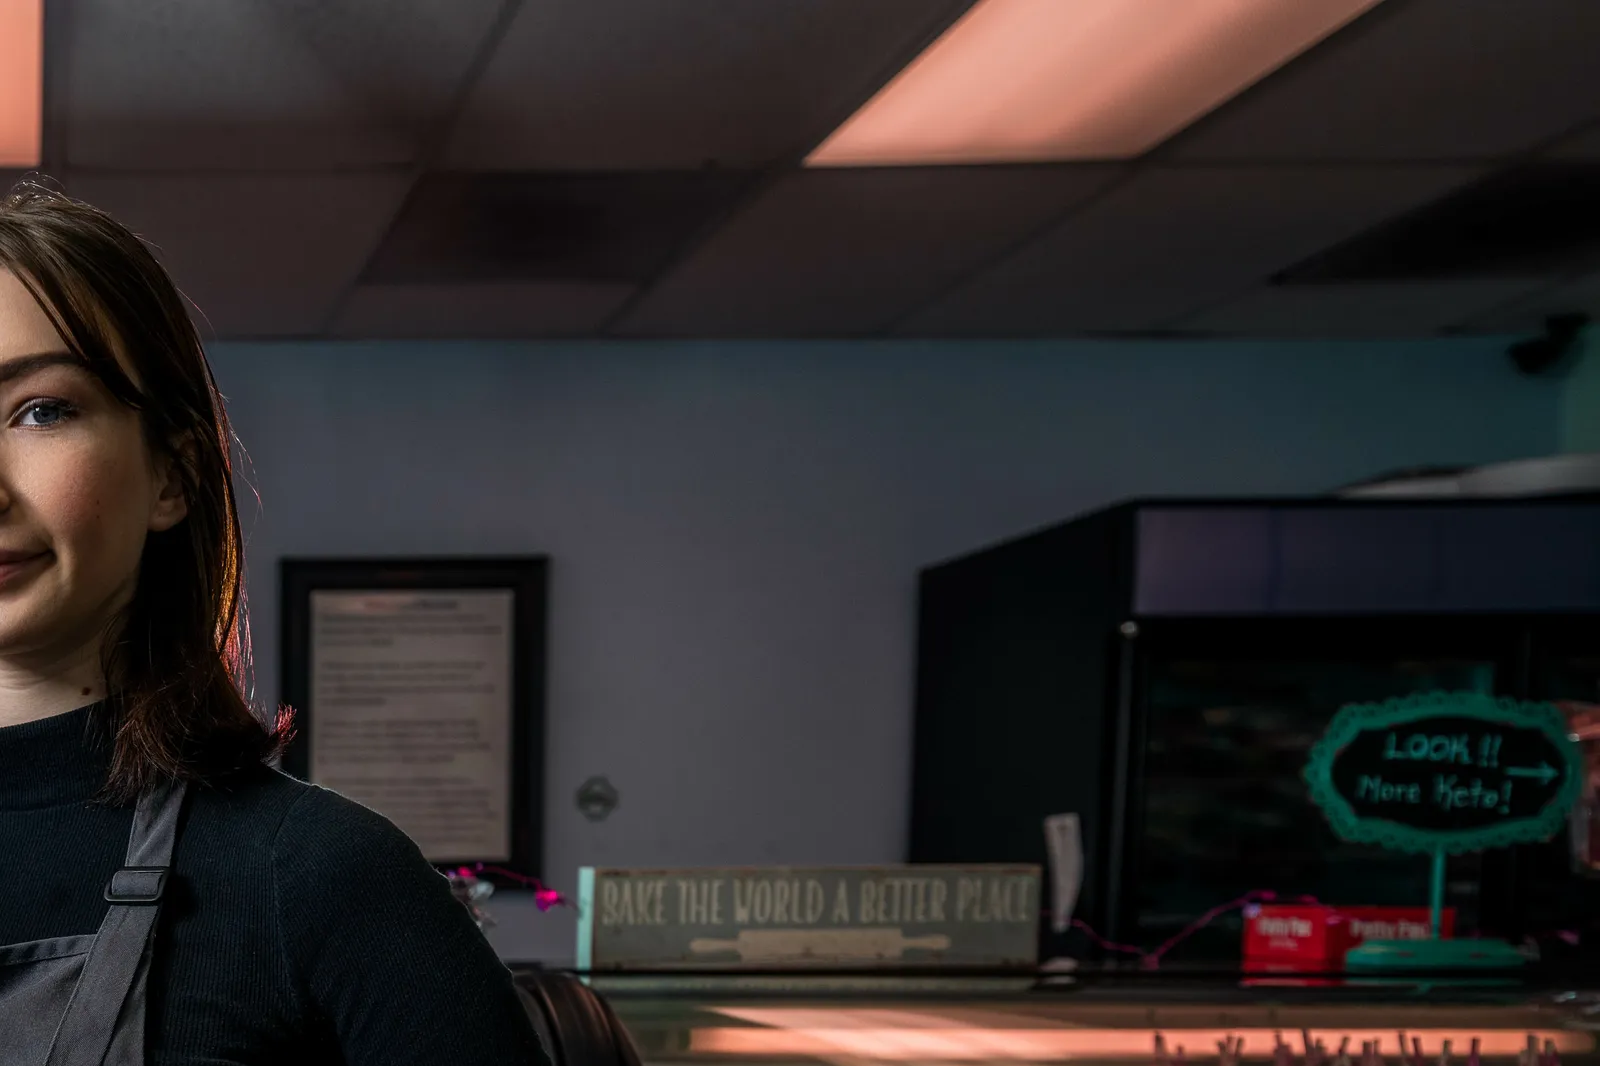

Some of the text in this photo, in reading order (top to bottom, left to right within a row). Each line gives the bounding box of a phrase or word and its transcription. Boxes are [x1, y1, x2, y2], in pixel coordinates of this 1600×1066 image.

[1355, 773, 1512, 815] More Keto!
[677, 879, 724, 924] THE
[732, 879, 823, 924] WORLD
[831, 879, 850, 924] A
[859, 879, 948, 924] BETTER
[955, 877, 1031, 923] PLACE
